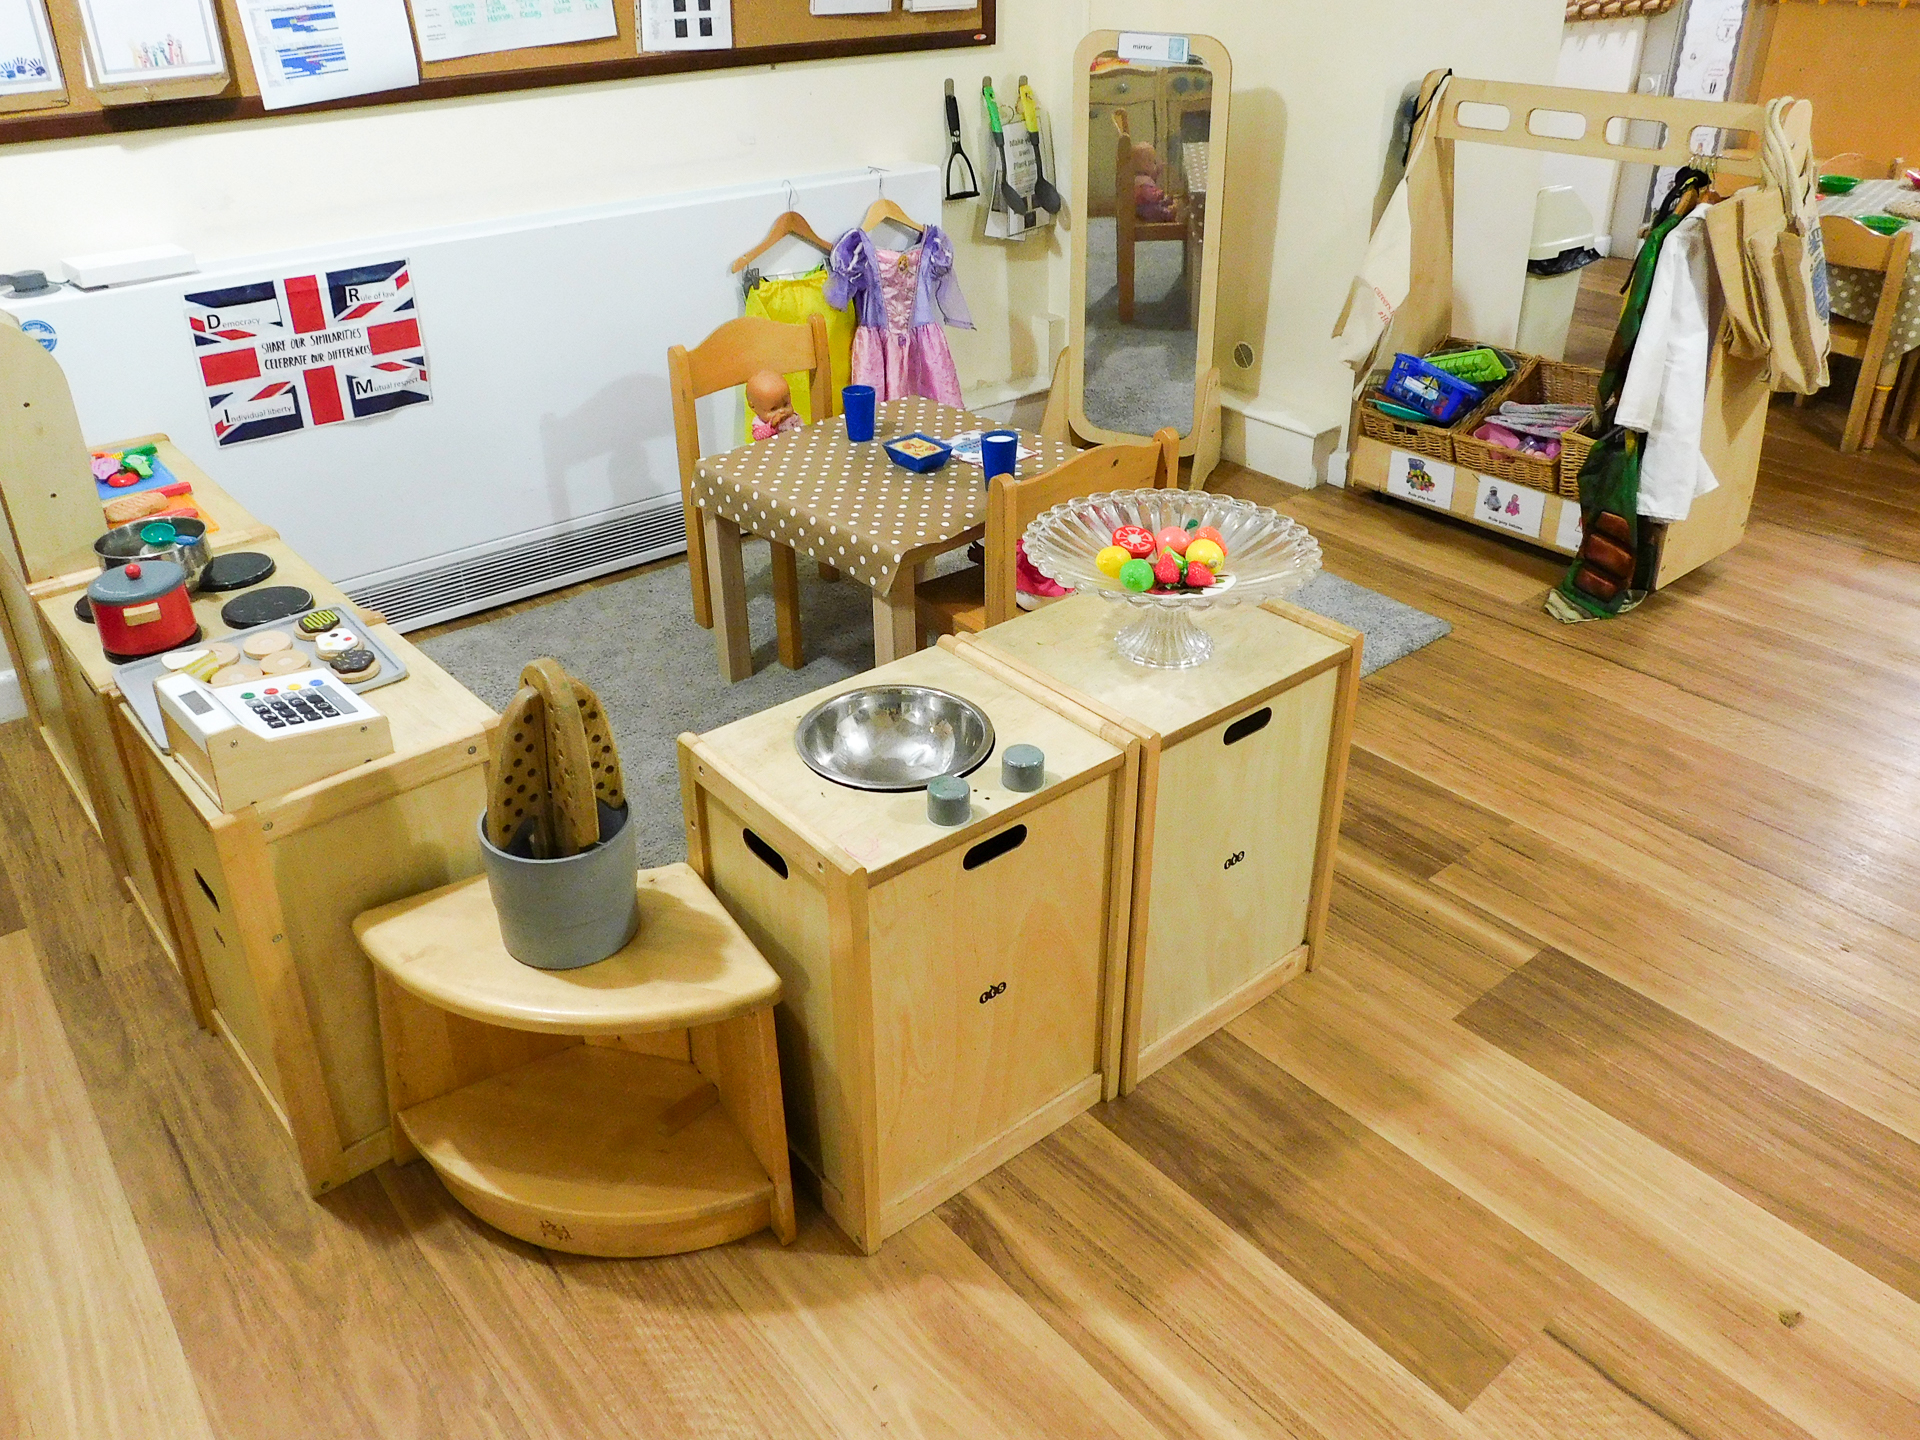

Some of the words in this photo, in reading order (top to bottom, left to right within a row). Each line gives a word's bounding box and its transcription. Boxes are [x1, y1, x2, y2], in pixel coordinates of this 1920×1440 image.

[348, 288, 372, 302] Rule
[207, 314, 260, 329] Democracy
[262, 340, 286, 354] SHARE
[291, 337, 306, 349] OUR
[310, 328, 361, 346] SIMILARITIES
[265, 354, 307, 369] CELEBRATE
[311, 353, 325, 364] OUR
[328, 344, 371, 360] DIFFERENCES
[355, 379, 393, 395] Mutual
[394, 377, 418, 388] respect
[224, 409, 266, 423] Individual
[267, 406, 292, 416] liberty
